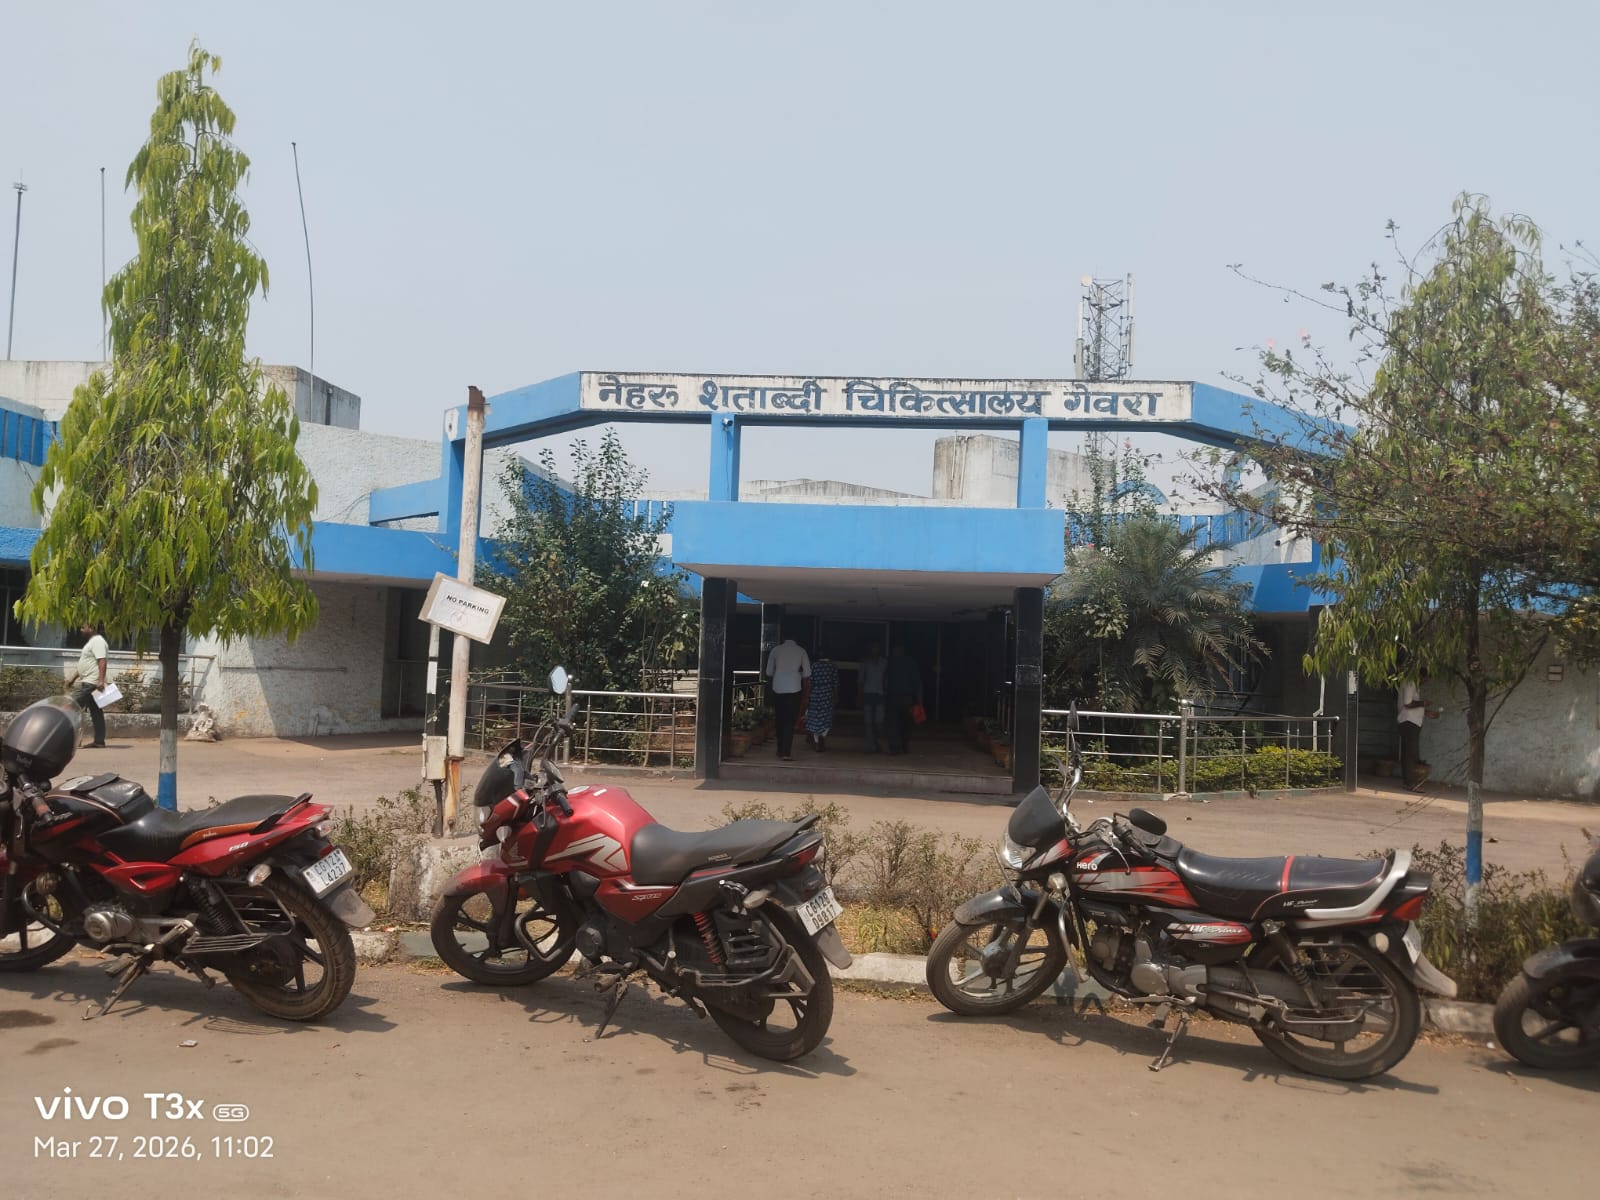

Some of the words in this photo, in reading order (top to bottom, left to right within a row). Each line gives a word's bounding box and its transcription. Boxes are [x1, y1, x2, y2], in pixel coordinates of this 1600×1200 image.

[699, 380, 828, 413] शताब्दी
[842, 380, 1051, 415] चिकित्सालय
[1063, 382, 1163, 416] गेवरा
[446, 594, 457, 603] NO
[458, 599, 489, 615] PARKING
